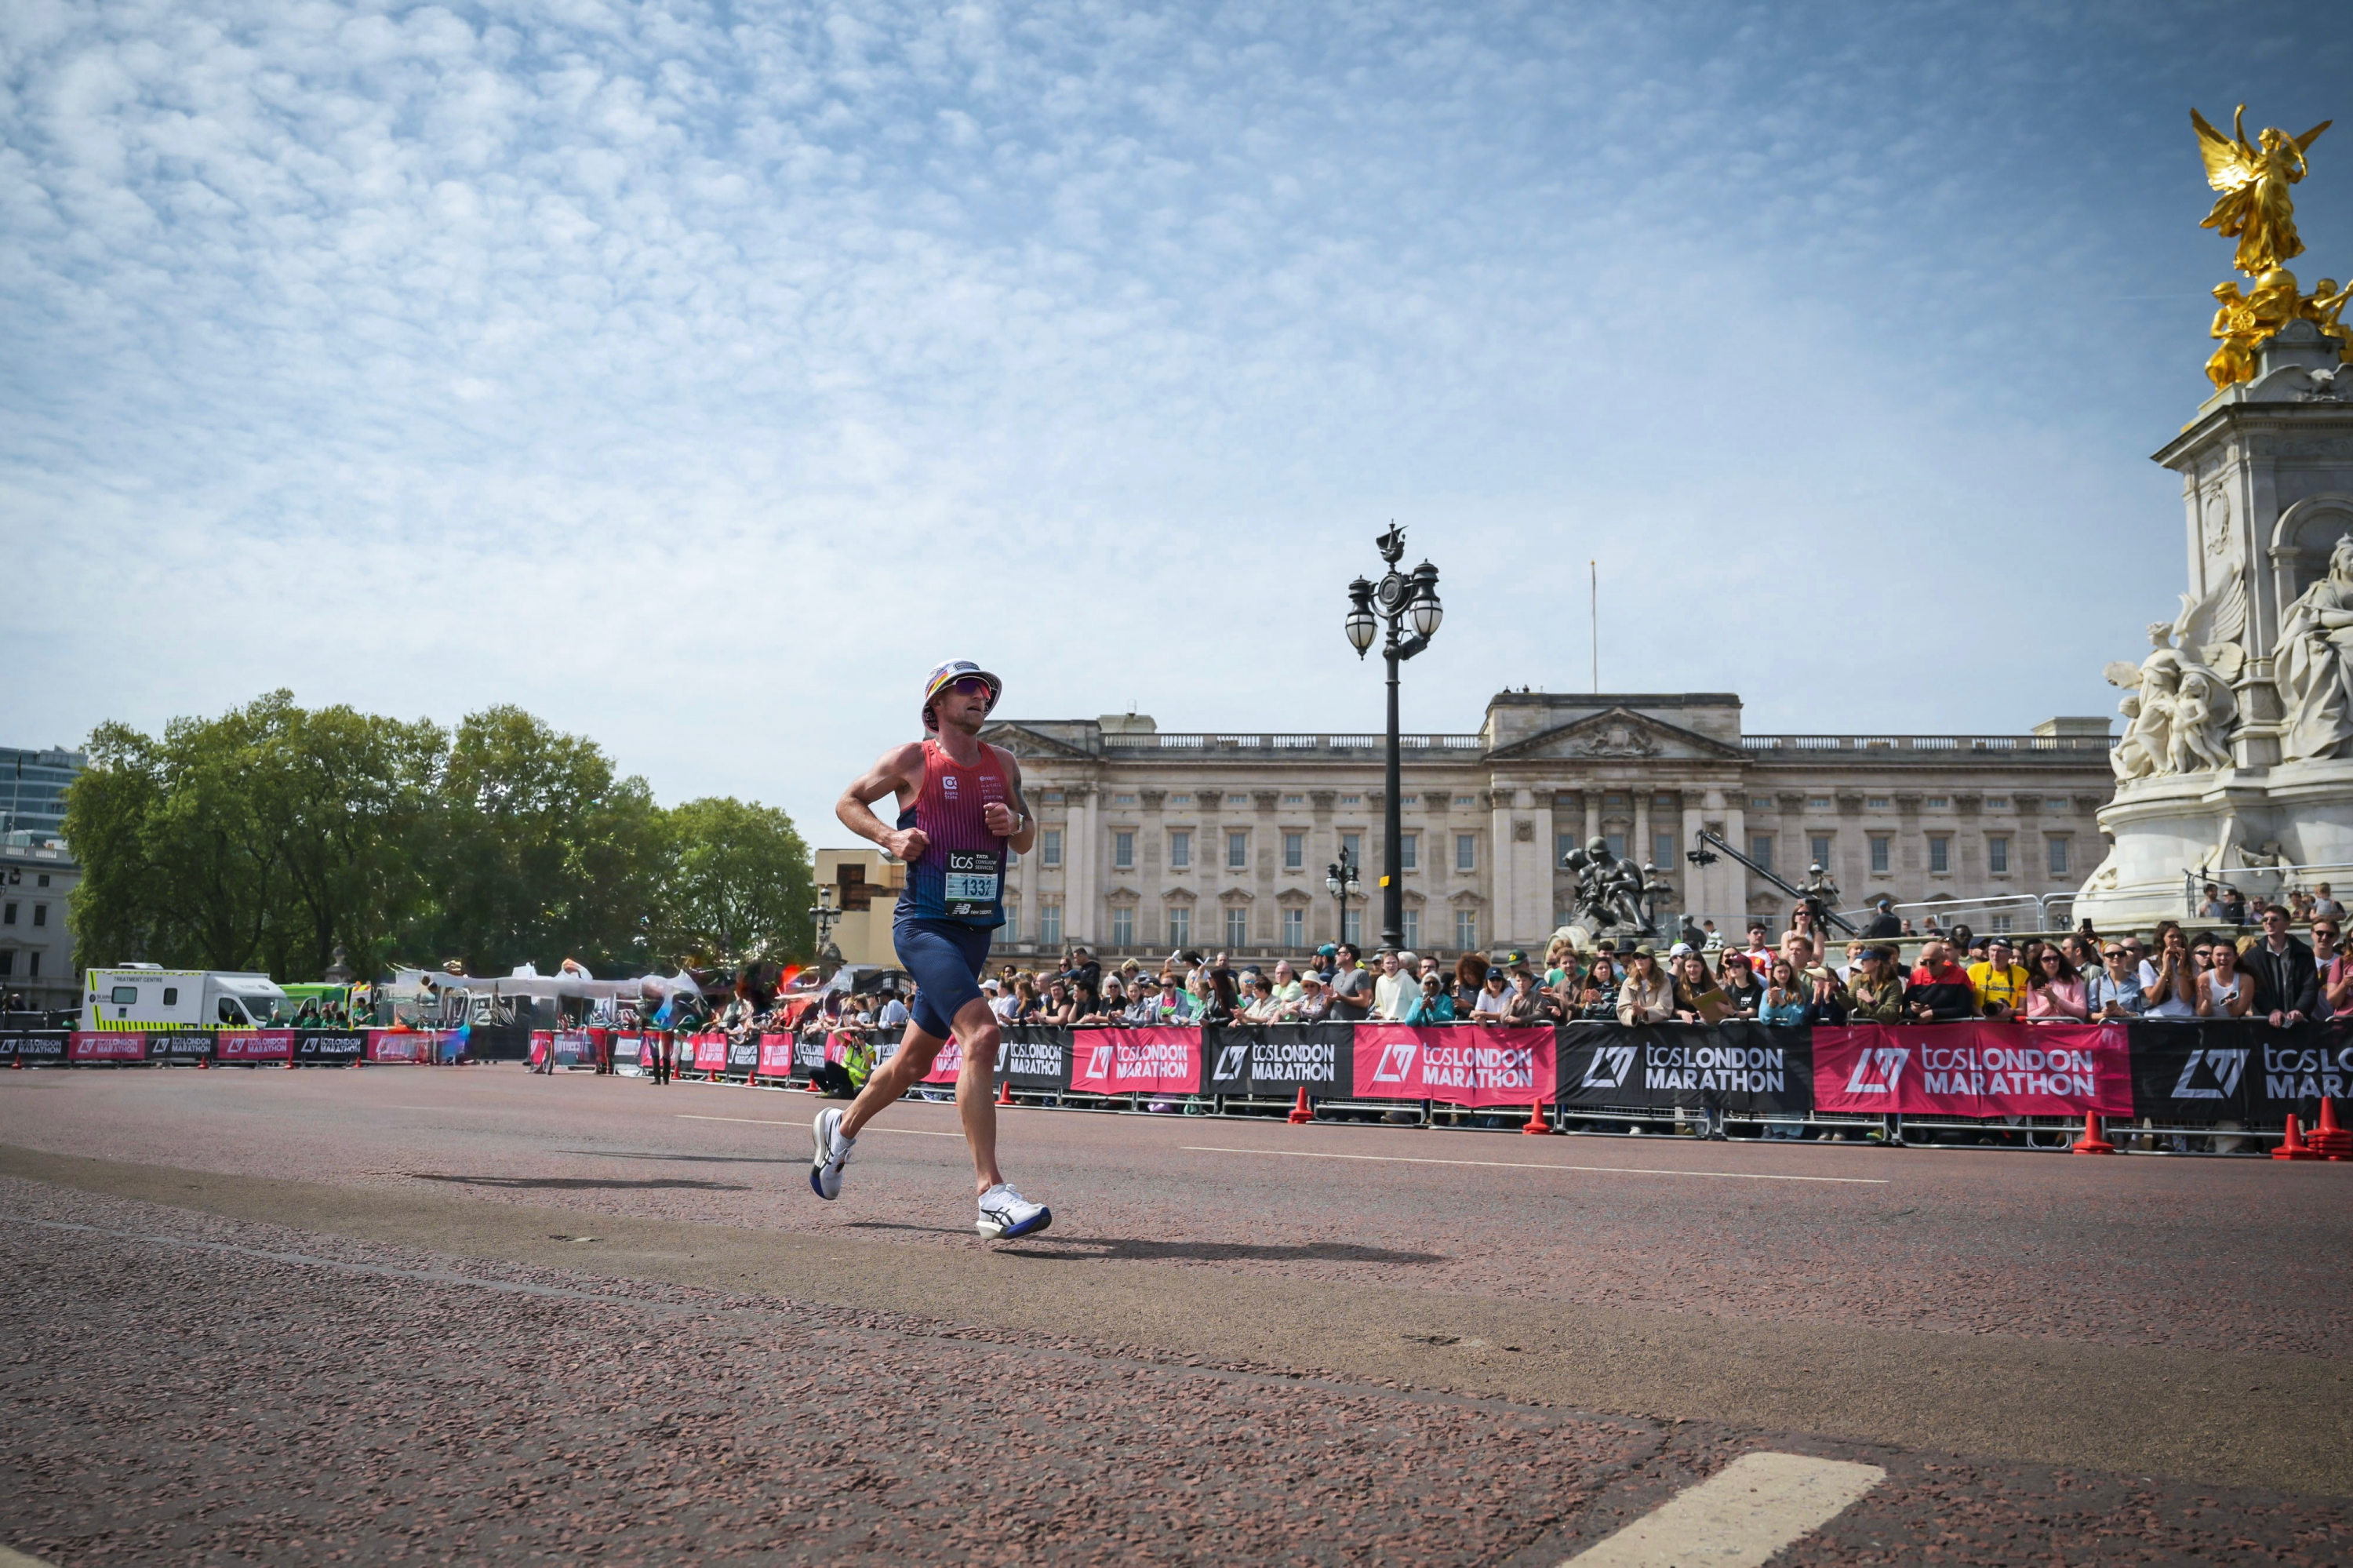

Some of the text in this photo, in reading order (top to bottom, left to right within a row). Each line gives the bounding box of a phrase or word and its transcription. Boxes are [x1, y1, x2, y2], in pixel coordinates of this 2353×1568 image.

[951, 853, 973, 869] tcs
[962, 879, 991, 896] 1332
[171, 1044, 211, 1053] MARATHON
[247, 1044, 287, 1053] MARATHON
[320, 1044, 361, 1053] MARATHON
[1009, 1058, 1061, 1075] MARATHON
[1116, 1061, 1187, 1079] MARATHON
[1251, 1062, 1335, 1081] MARATHON
[1422, 1065, 1533, 1088] MARATHON
[1646, 1068, 1784, 1093] MARATHON
[1924, 1071, 2095, 1096] MARATHON
[2266, 1075, 2353, 1098] MAR
